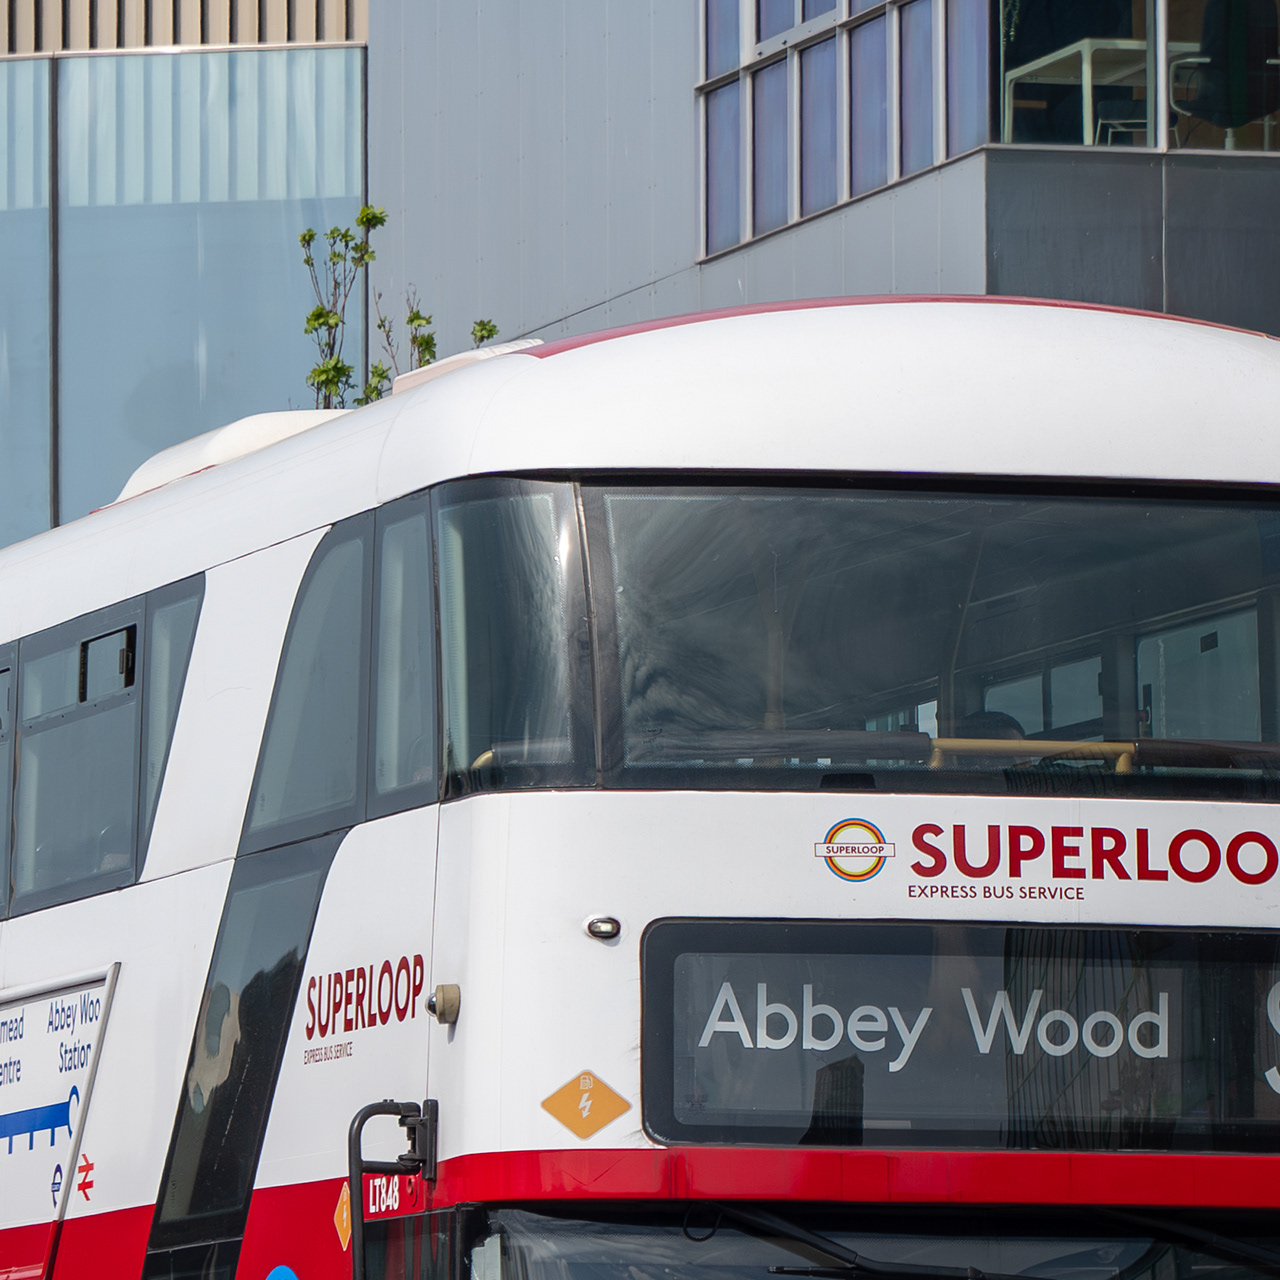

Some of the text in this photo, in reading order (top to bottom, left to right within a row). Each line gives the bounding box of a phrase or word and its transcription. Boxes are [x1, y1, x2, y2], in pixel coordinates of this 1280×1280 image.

[825, 845, 885, 855] SUPERLOOP
[908, 885, 1085, 900] EXPRESS BUS SERVICE
[47, 992, 101, 1036] Abbey Woo
[305, 954, 424, 1040] SUPERLOOP
[697, 982, 1169, 1072] Abbey Wood
[369, 1174, 400, 1214] LT848
